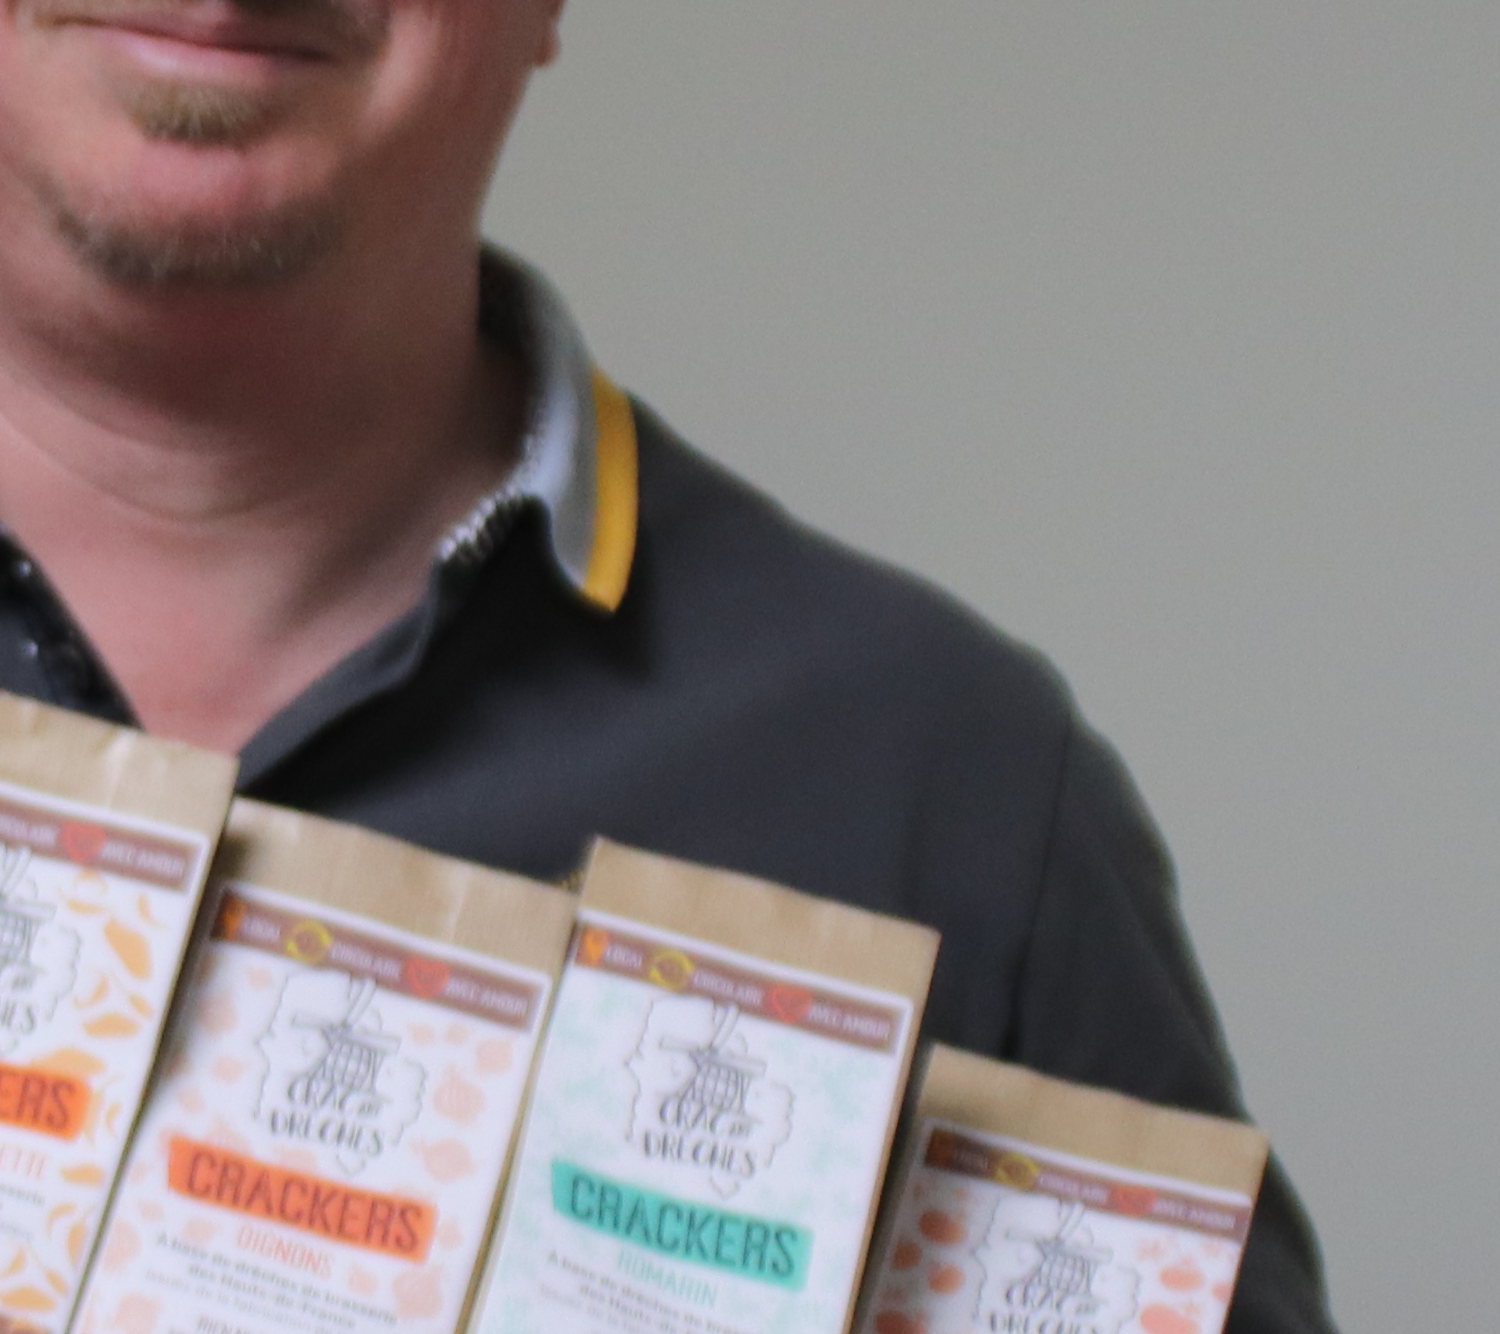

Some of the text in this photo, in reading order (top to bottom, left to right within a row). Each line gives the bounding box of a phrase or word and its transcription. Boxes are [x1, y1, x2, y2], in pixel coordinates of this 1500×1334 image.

[186, 1147, 425, 1255] CRACKERS
[569, 1172, 799, 1281] CRACKERS
[186, 1262, 218, 1283] des
[233, 1222, 338, 1279] OIGNONS
[614, 1249, 720, 1311] ROMARIN
[578, 1282, 607, 1303] des
